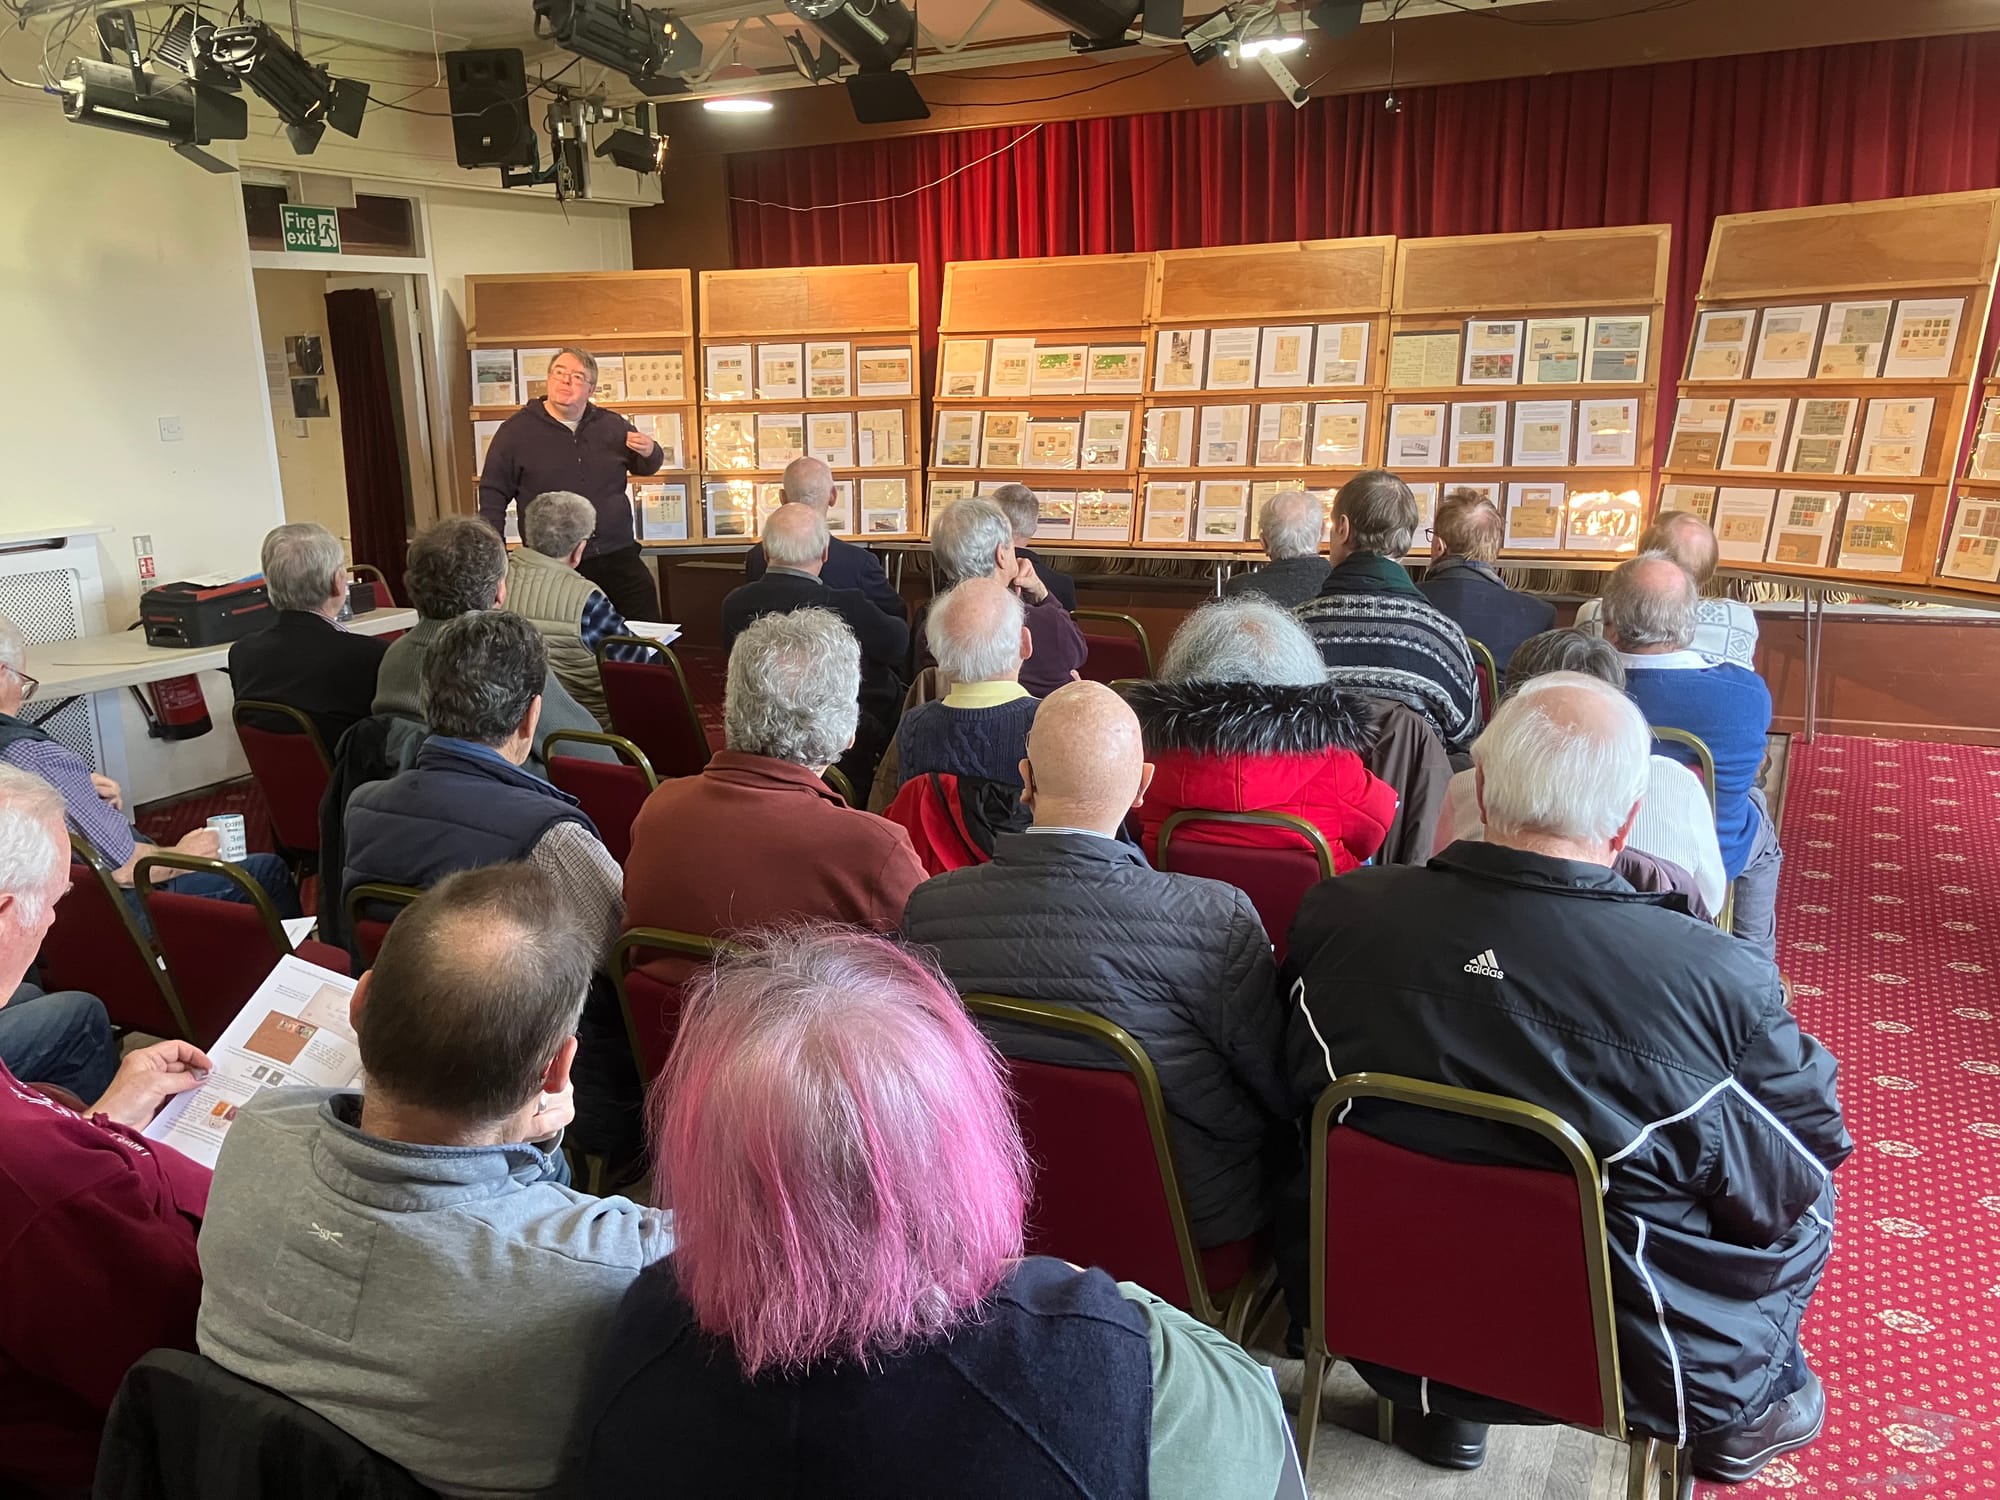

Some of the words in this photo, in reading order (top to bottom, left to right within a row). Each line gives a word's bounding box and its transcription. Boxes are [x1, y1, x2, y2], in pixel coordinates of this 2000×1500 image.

[284, 211, 316, 230] Fire
[287, 229, 317, 246] exit
[1463, 963, 1504, 980] adidas
